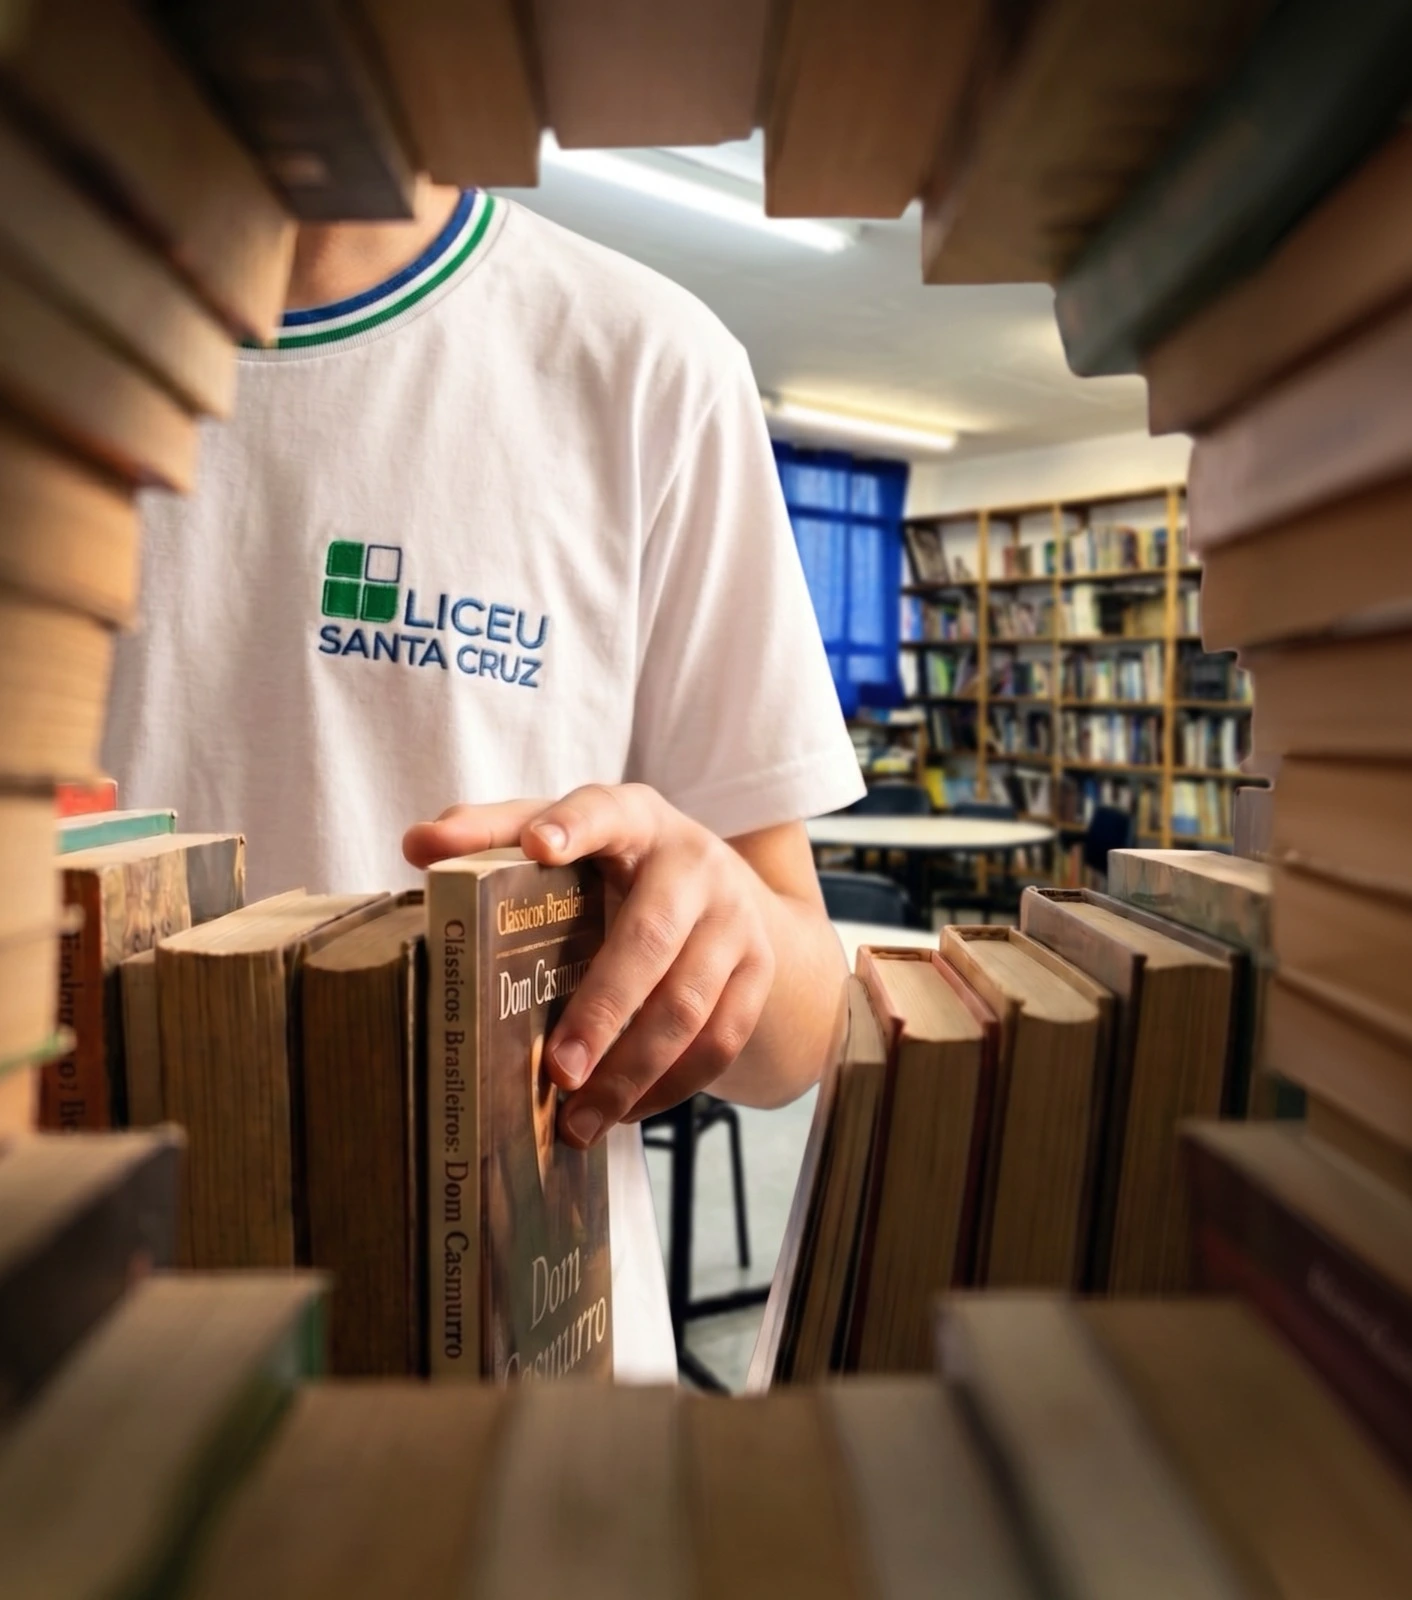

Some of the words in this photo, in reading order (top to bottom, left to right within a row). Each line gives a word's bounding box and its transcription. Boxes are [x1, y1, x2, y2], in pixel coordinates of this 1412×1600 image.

[404, 589, 549, 650] LICEU
[318, 625, 449, 671] SANTA
[456, 643, 543, 689] CRUZ
[496, 898, 545, 936] Clássicos
[444, 919, 466, 1023] Clássicos
[499, 971, 532, 1021] Dom
[534, 958, 591, 1006] Casmurr
[444, 1030, 466, 1154] Brasileiros:
[444, 1161, 469, 1223] Dom
[444, 1231, 470, 1360] Casmurro
[530, 1246, 582, 1332] Dom
